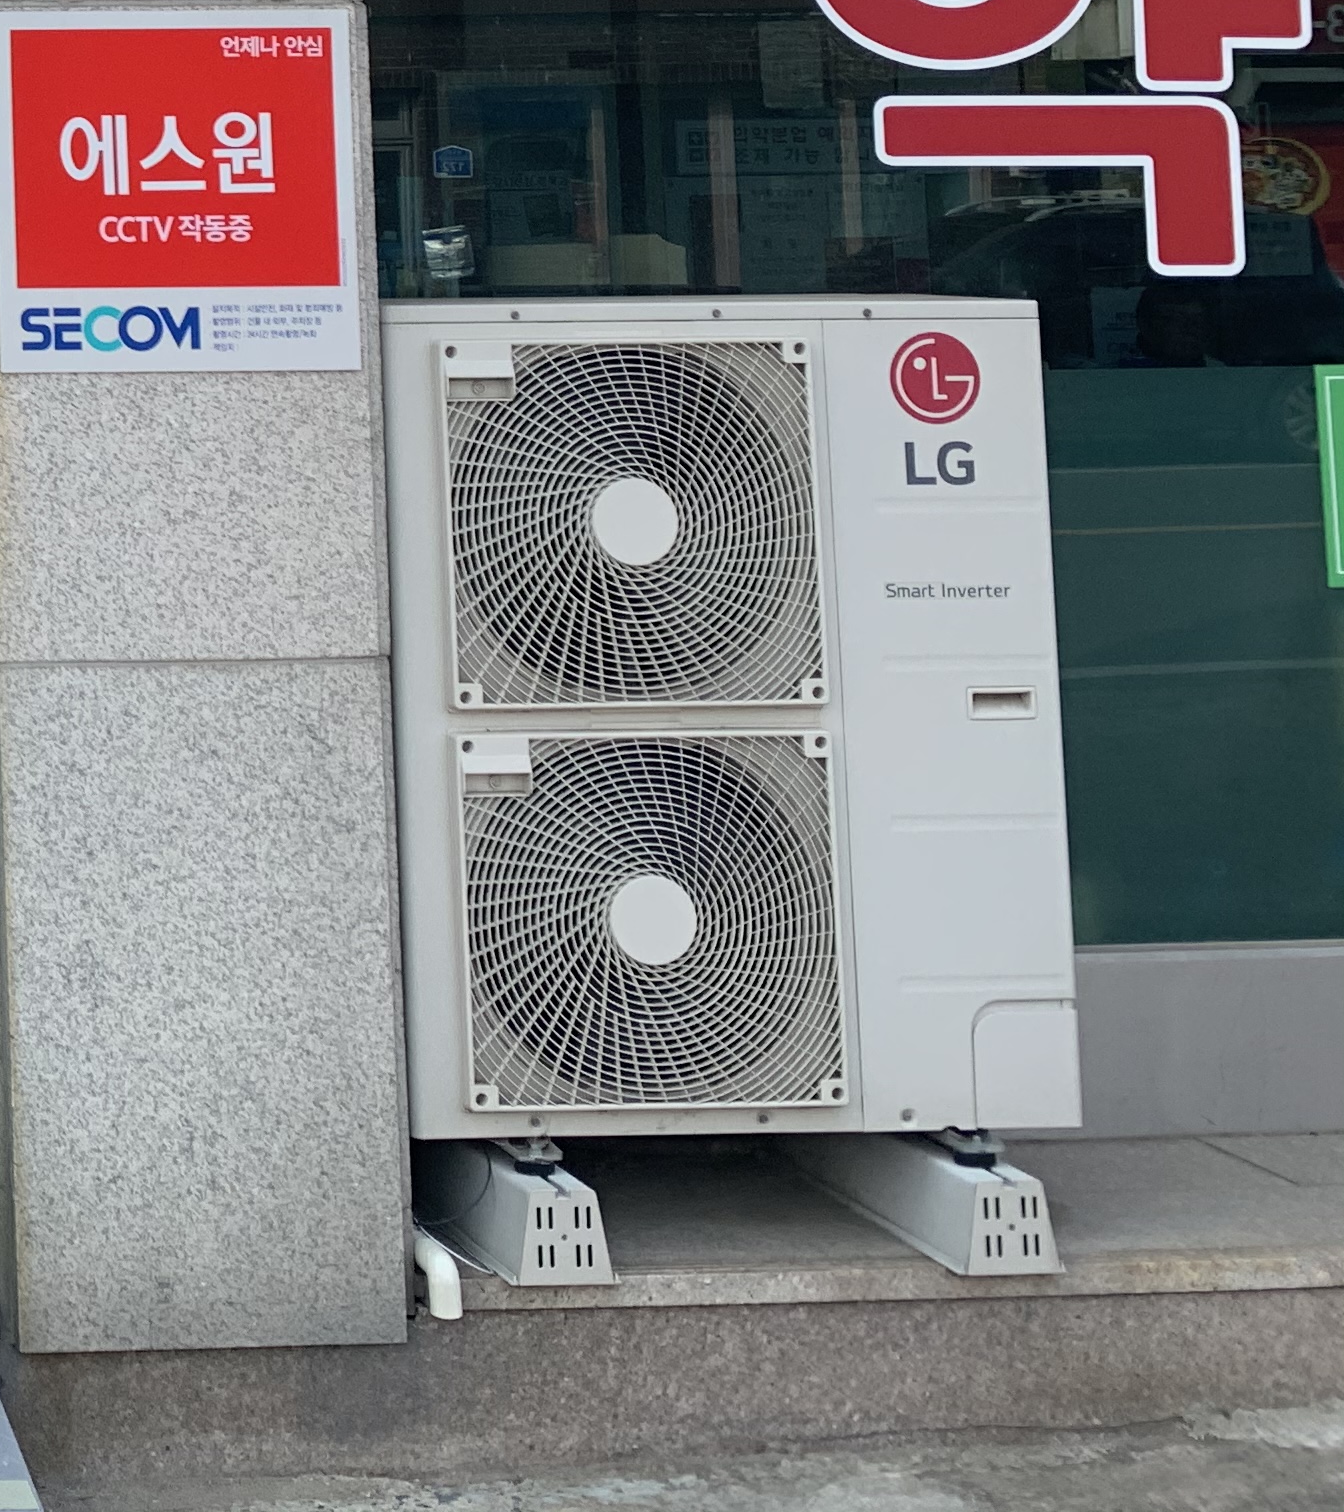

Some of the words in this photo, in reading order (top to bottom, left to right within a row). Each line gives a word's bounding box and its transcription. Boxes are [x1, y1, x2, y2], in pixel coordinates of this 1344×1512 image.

[219, 35, 281, 58] 언제나
[283, 35, 324, 58] 안심
[59, 111, 276, 196] 에스원
[98, 215, 175, 243] CCTV
[177, 213, 254, 243] 작동중
[20, 305, 201, 352] SECOM
[904, 441, 976, 486] LG
[885, 582, 935, 598] Smart
[941, 582, 1011, 598] Inverter
